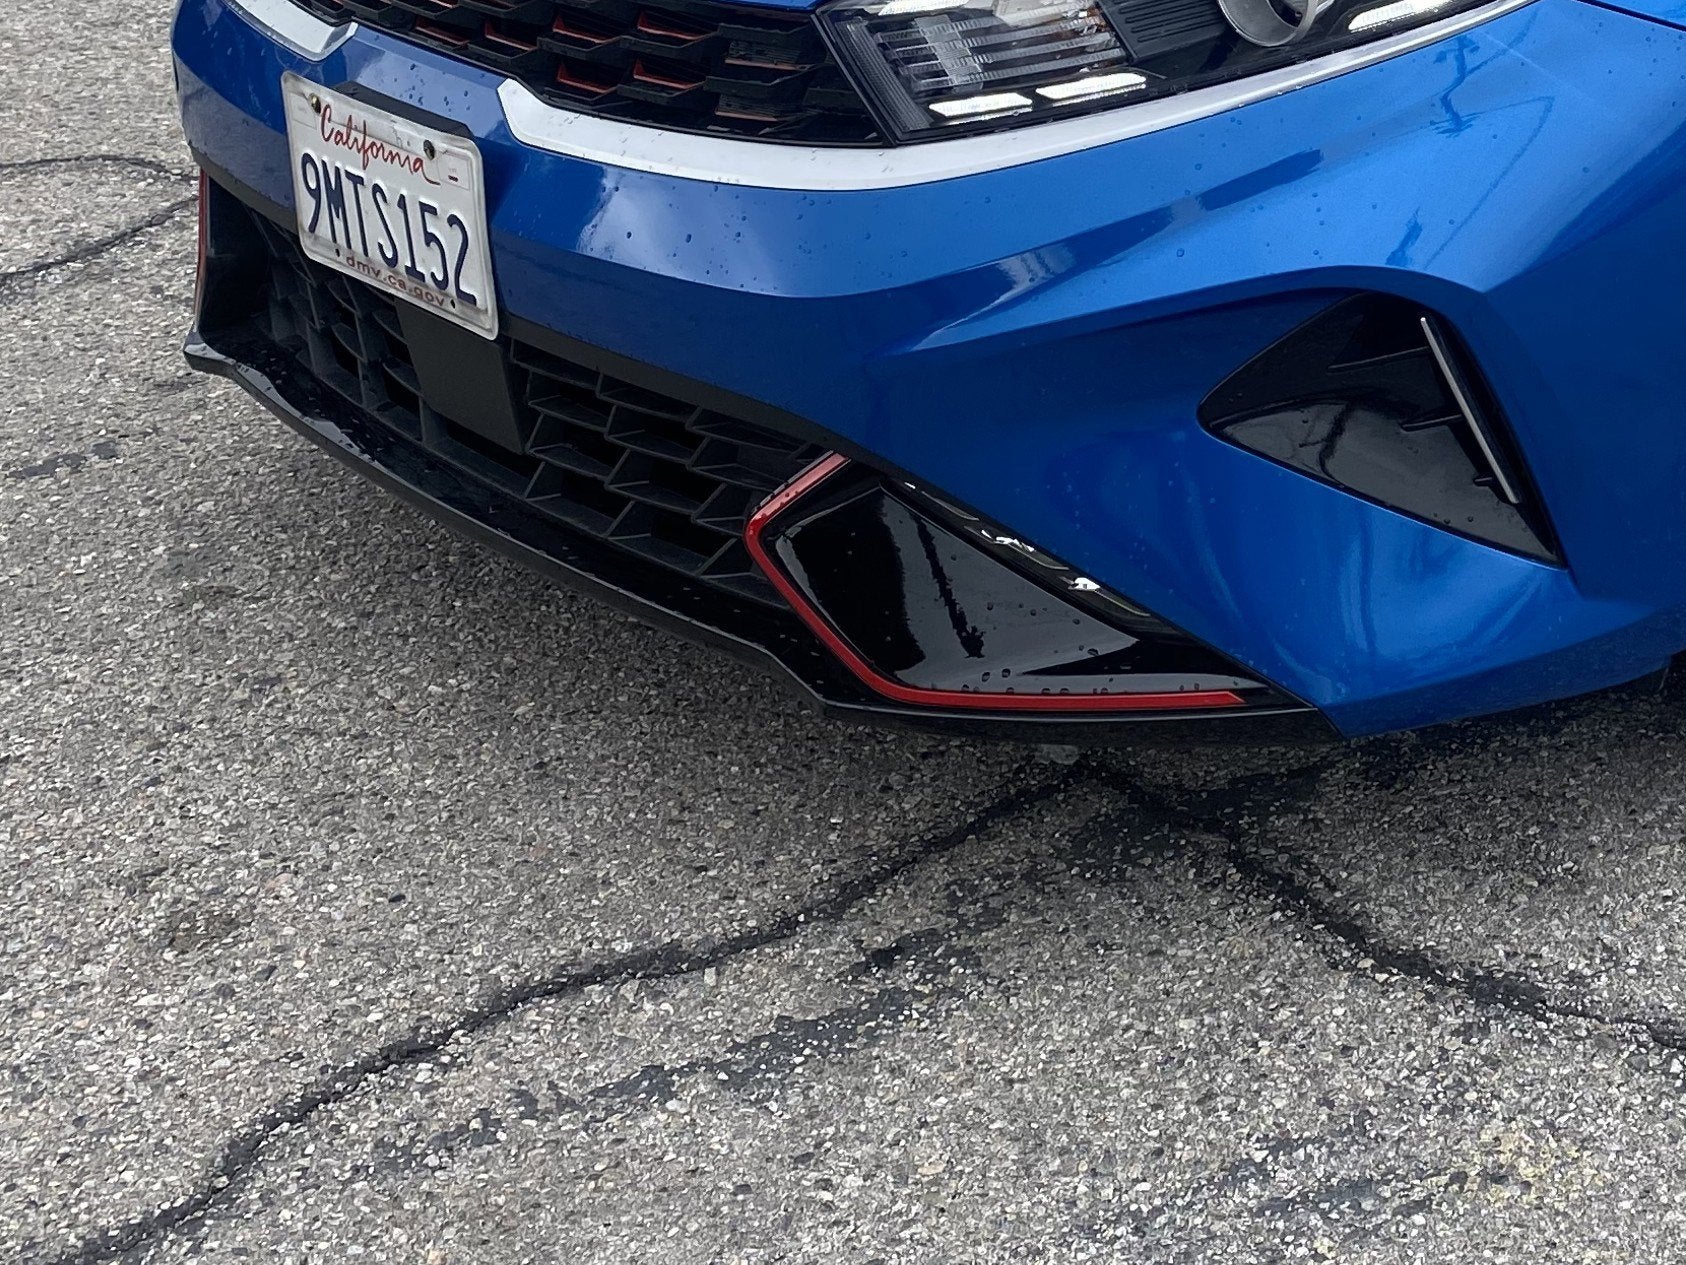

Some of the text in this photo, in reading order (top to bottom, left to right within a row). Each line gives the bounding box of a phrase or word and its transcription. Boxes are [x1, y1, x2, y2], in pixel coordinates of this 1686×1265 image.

[320, 104, 441, 185] California
[302, 152, 477, 306] 9MTS152
[346, 255, 445, 307] dmv.ca.gov
